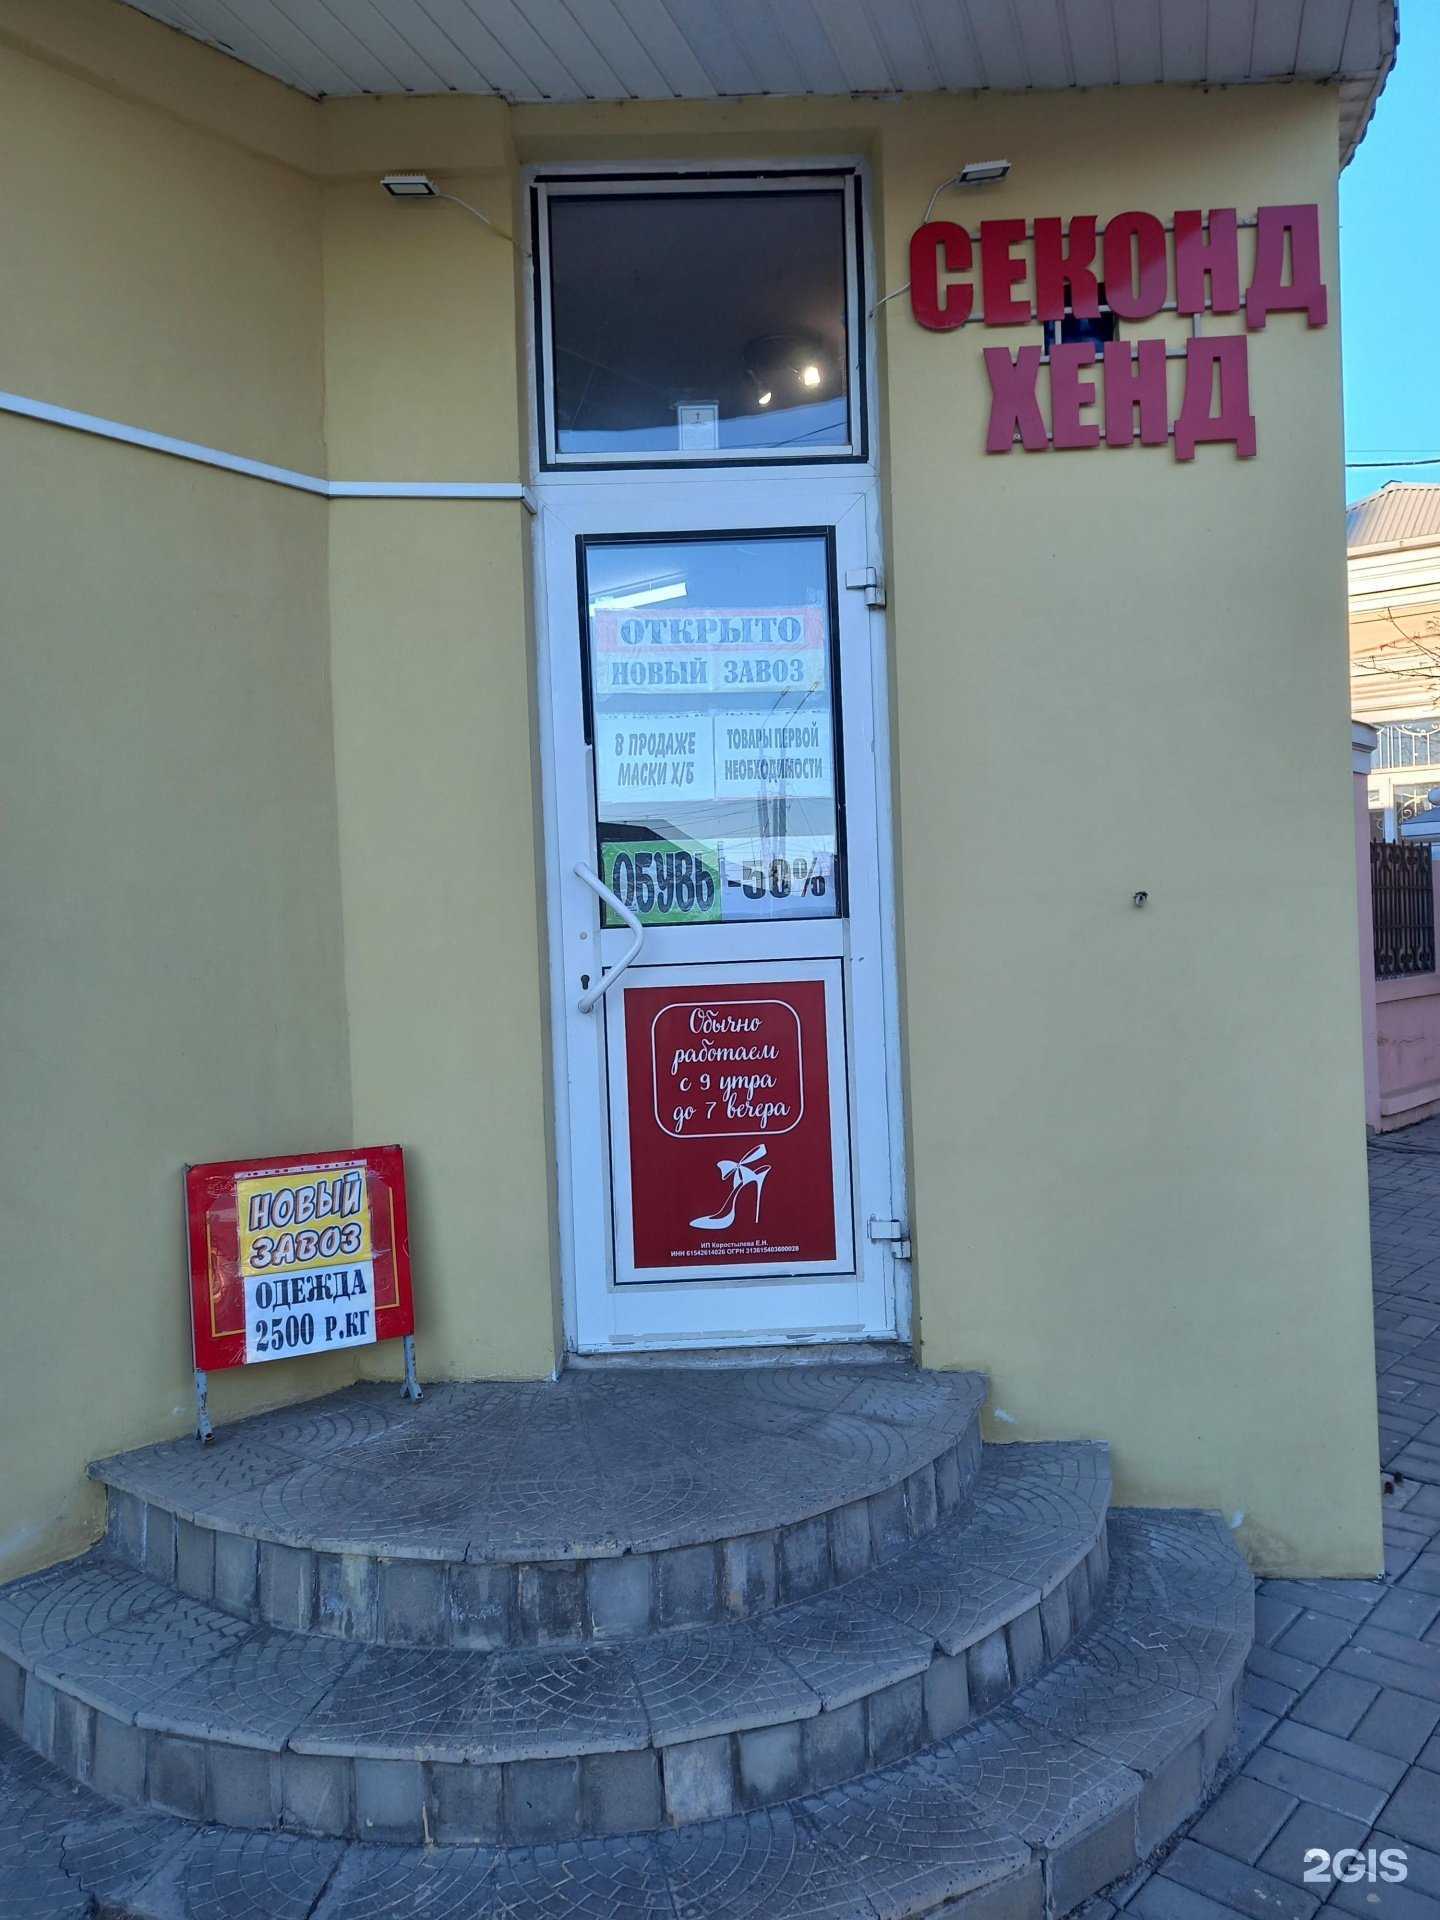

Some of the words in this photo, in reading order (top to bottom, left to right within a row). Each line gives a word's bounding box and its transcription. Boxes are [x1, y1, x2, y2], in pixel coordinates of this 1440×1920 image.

[910, 204, 1327, 332] СЕКОНД
[983, 335, 1256, 460] ХЕНД
[620, 616, 802, 645] ОТКРЫТО
[612, 657, 708, 685] НОВЫЙ
[723, 659, 804, 684] ЗАВОЗ
[615, 733, 623, 756] В
[628, 732, 696, 758] ПРОДАЖЕ
[727, 728, 772, 749] ТОВАРЫ
[774, 721, 819, 749] ПЕРВОЙ
[617, 763, 667, 787] МАСКИ
[670, 762, 695, 787] Х/Б
[725, 758, 823, 783] НЕОБХОДИМОСТИ
[613, 851, 715, 914] ОБУВЬ
[728, 855, 826, 900] -50%
[689, 1008, 762, 1034] Обычно
[671, 1039, 779, 1075] работаем
[679, 1077, 691, 1092] с
[700, 1073, 711, 1091] 9
[719, 1073, 777, 1101] утра
[673, 1105, 696, 1133] до
[704, 1101, 717, 1119] 7
[726, 1093, 791, 1129] вечера
[249, 1172, 363, 1232] НОВЫЙ
[250, 1222, 362, 1269] ЗАВОЗ
[255, 1269, 367, 1312] ОДЕЖДА
[255, 1313, 315, 1352] 2500
